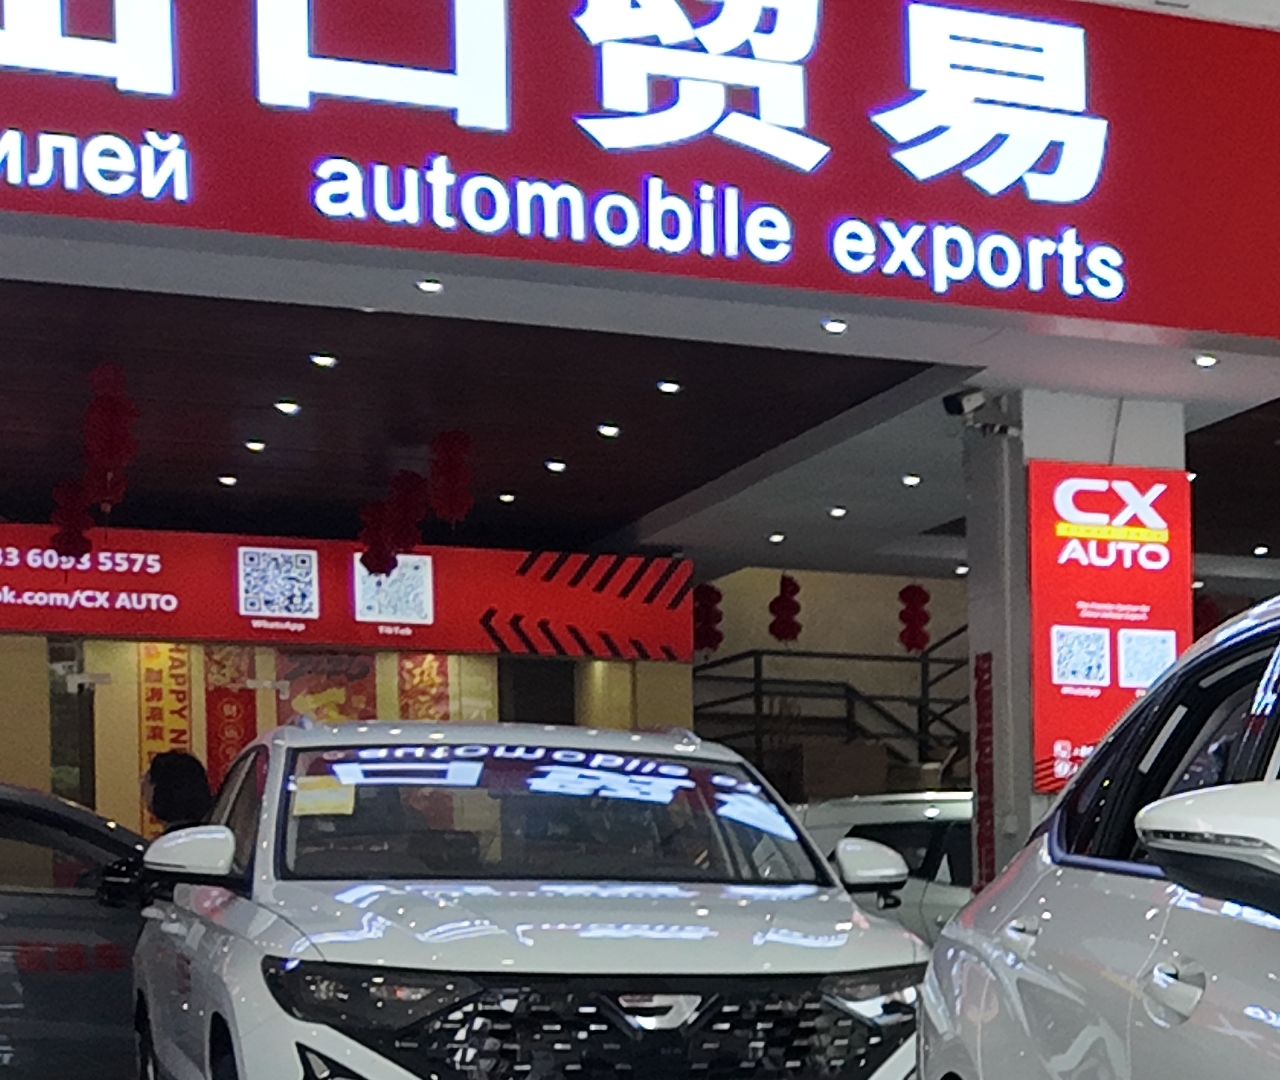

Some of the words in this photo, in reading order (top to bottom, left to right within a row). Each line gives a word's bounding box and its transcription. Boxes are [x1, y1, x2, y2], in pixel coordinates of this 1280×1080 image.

[0, 0, 1108, 204] 口贸易
[314, 155, 796, 263] automobile
[832, 218, 1125, 300] exports
[1053, 477, 1168, 529] CX
[0, 547, 20, 567] 3
[98, 551, 162, 574] 5575
[1057, 538, 1170, 570] AUTO
[0, 585, 110, 609] k.com/CX
[115, 592, 178, 612] AUTO
